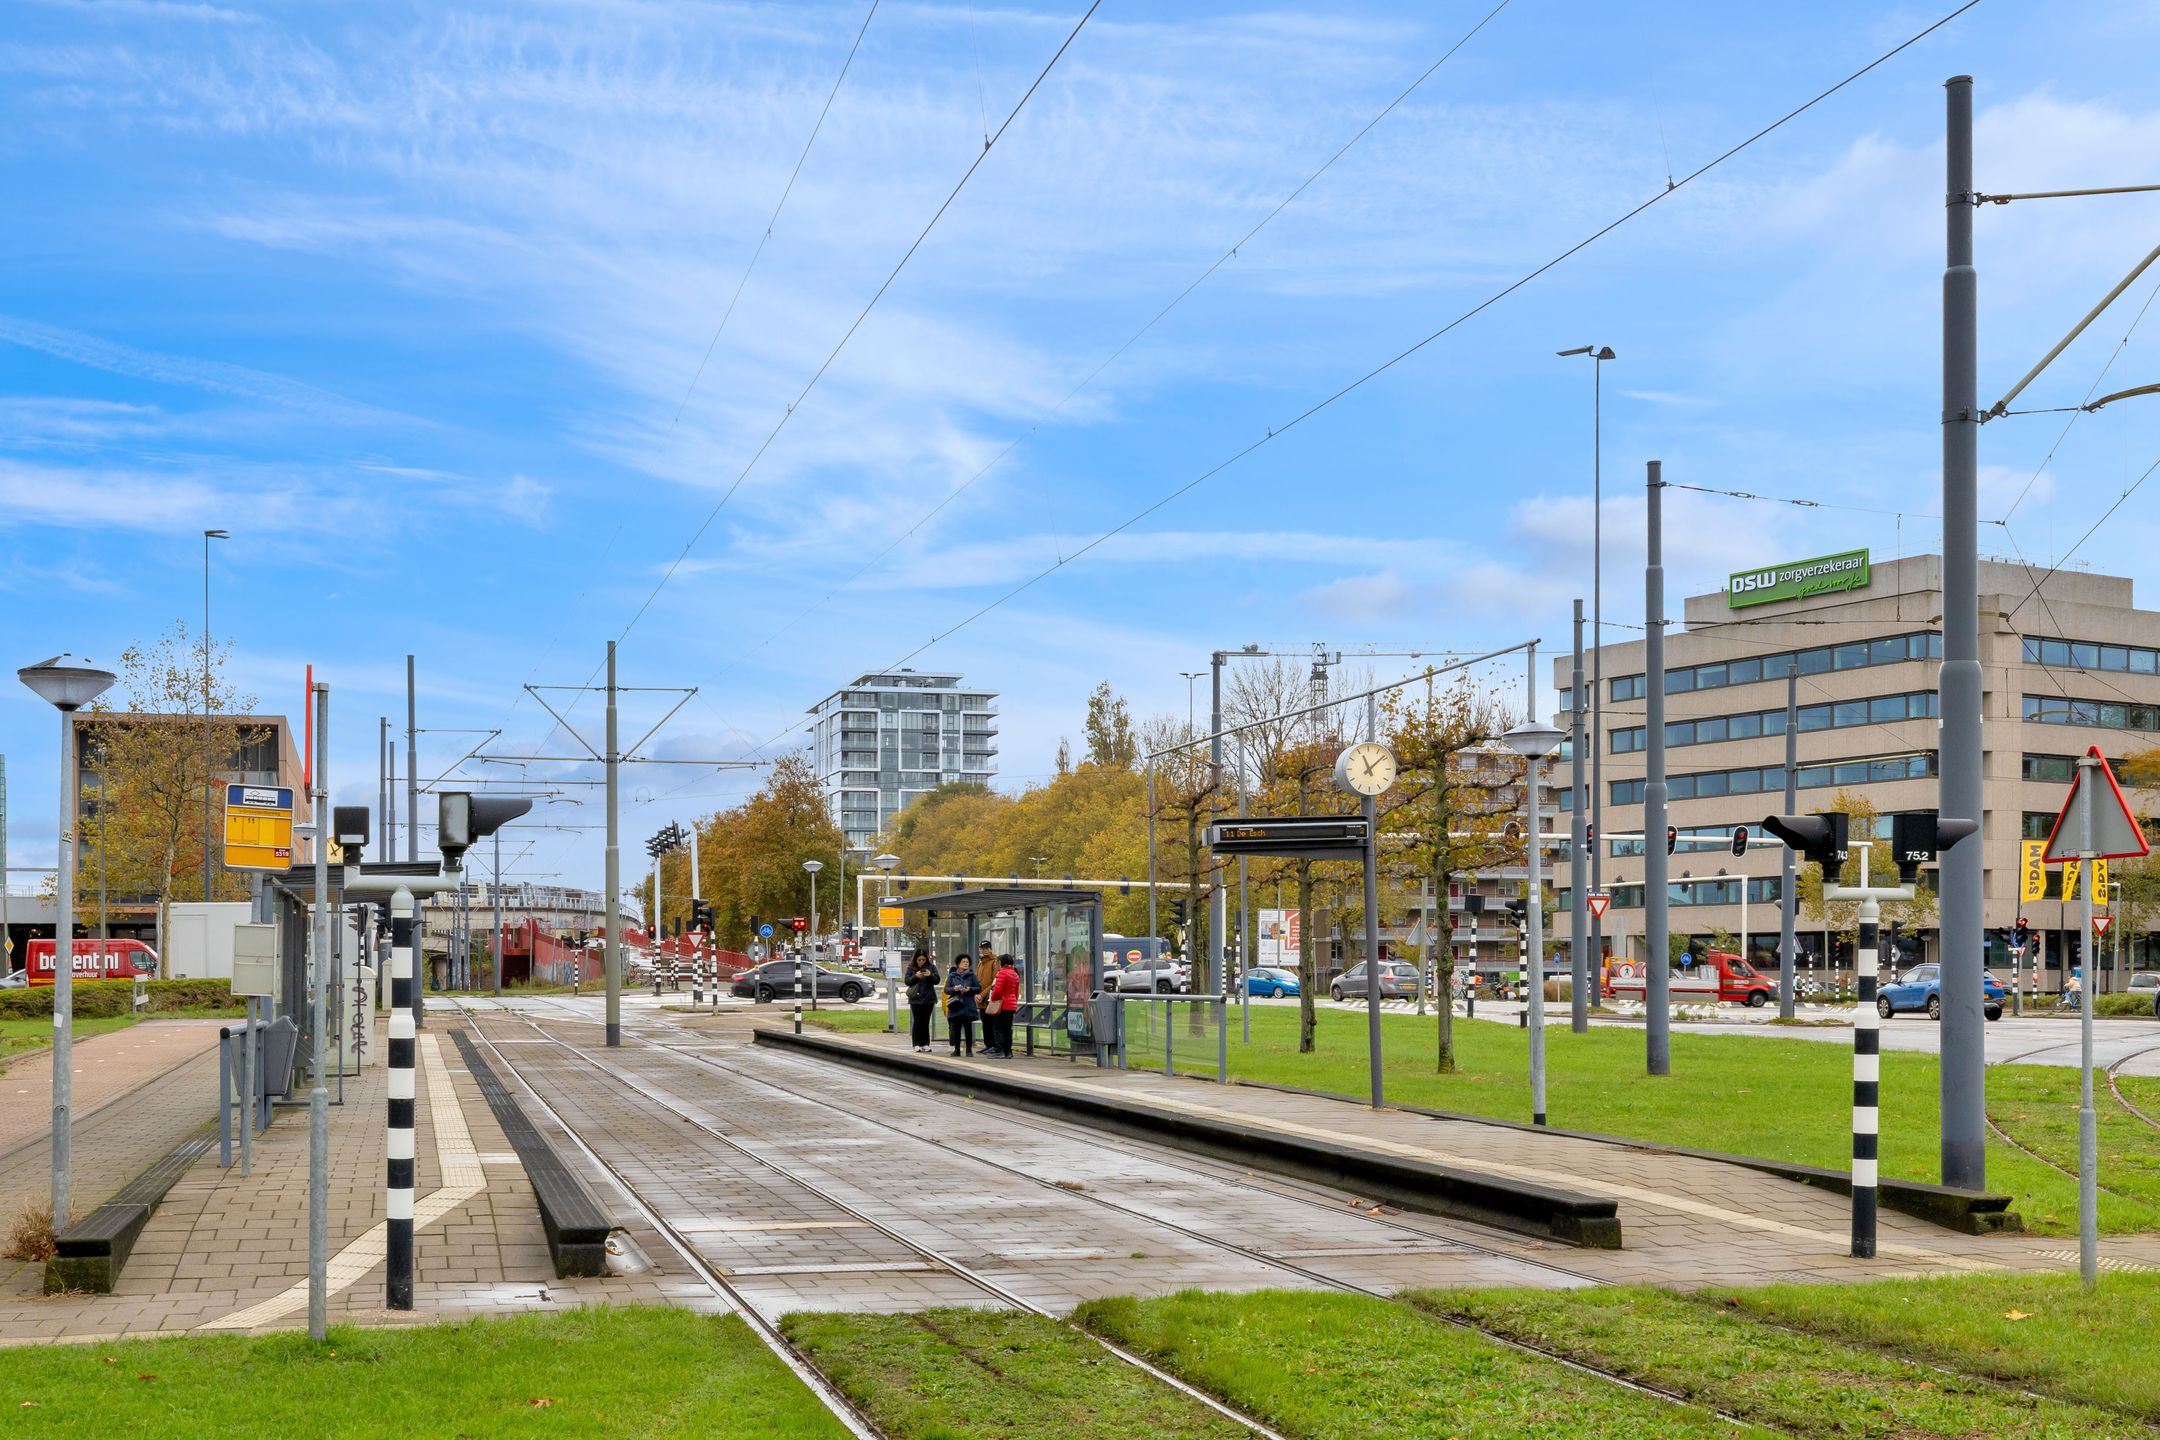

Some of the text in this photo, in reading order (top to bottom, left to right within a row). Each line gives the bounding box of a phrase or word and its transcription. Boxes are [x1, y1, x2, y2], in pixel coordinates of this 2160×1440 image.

[1732, 556, 1864, 593] DSW zorgverzekeraar
[1905, 851, 1929, 861] 75.2
[2029, 844, 2042, 895] S'DAM
